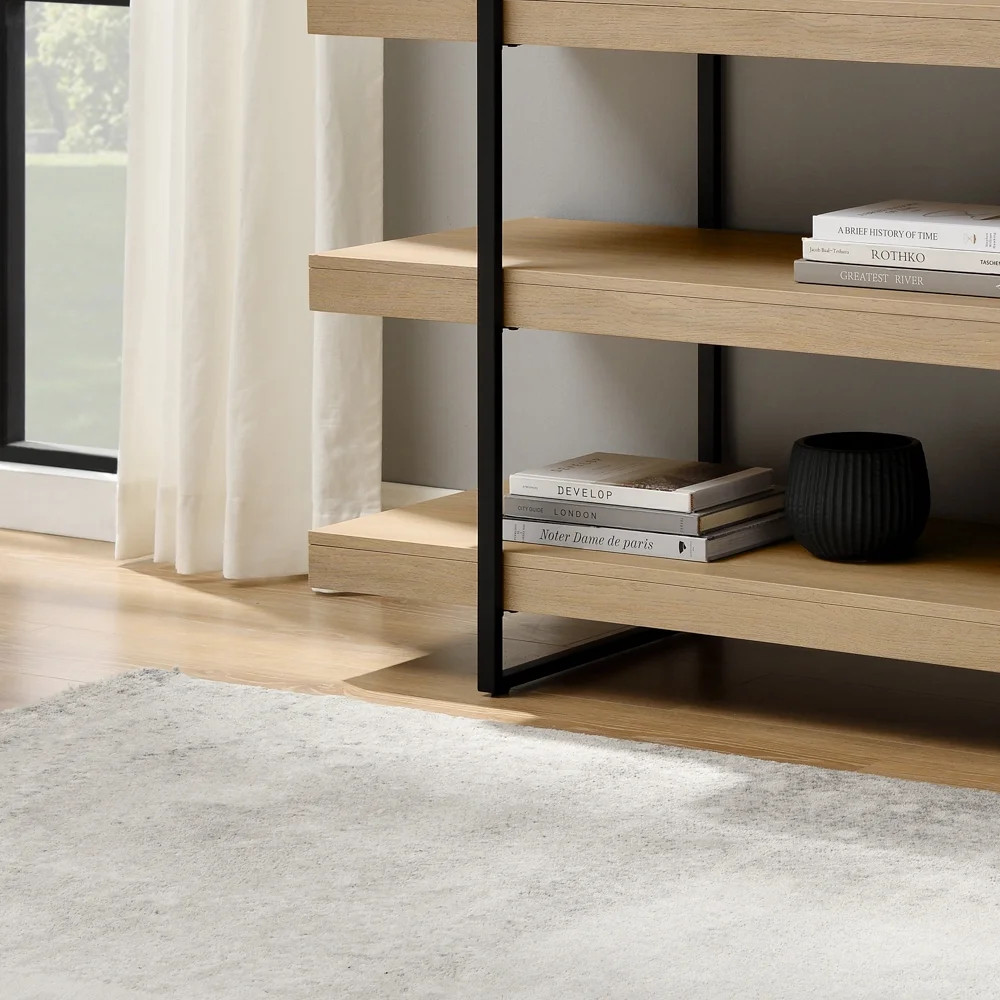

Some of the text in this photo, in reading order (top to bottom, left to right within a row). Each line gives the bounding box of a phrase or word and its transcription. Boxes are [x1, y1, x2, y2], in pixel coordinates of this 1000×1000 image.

[837, 226, 938, 241] A BRIEF HISTORY OF TIME
[871, 249, 926, 264] ROTHKO
[840, 271, 924, 286] GREATEST RIVER
[557, 485, 613, 501] DEVELOP
[553, 508, 597, 520] LONDON
[539, 528, 571, 543] Noter
[573, 531, 605, 546] Dame
[607, 535, 621, 548] de
[623, 537, 654, 553] paris
